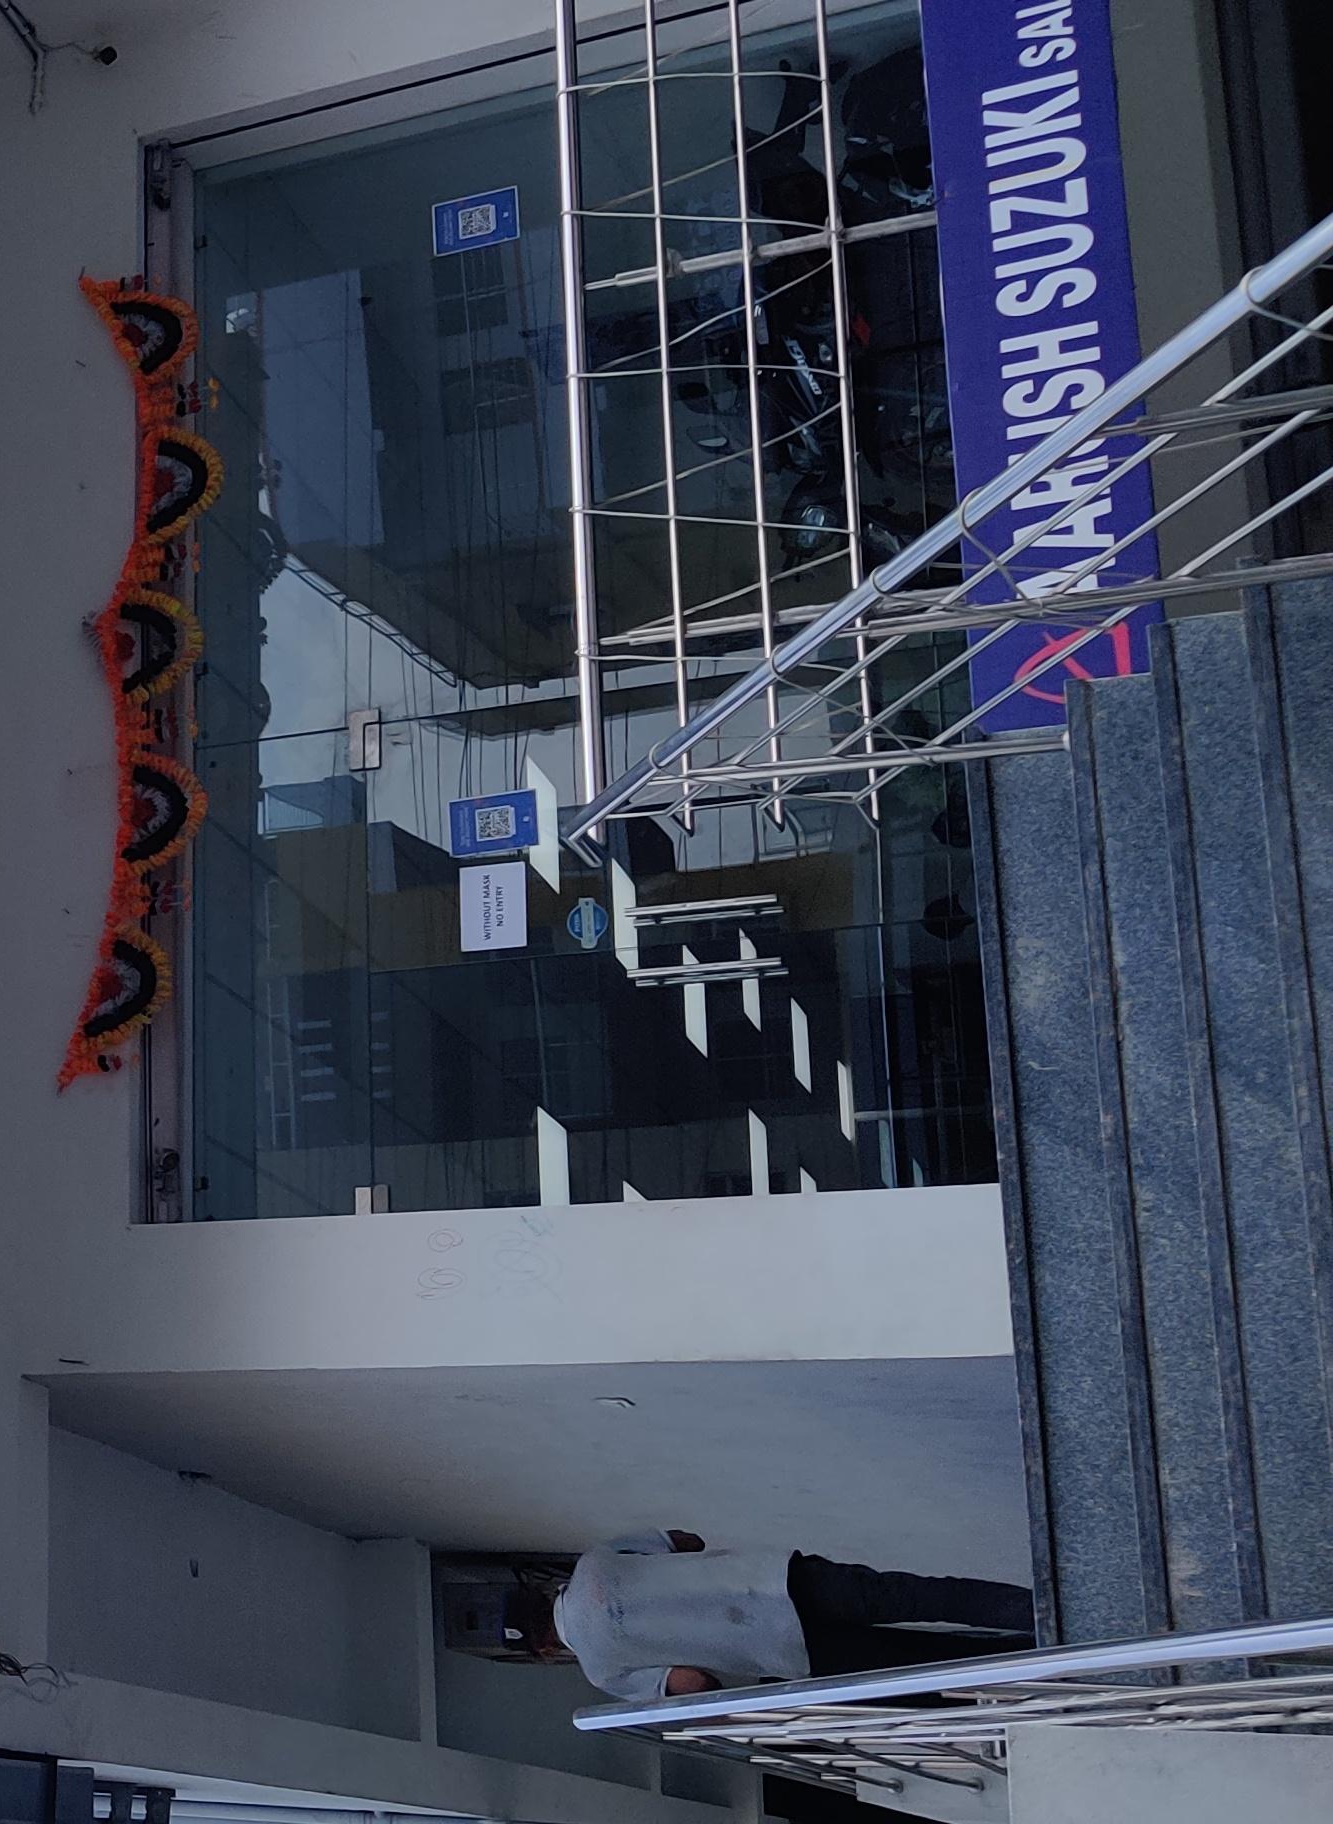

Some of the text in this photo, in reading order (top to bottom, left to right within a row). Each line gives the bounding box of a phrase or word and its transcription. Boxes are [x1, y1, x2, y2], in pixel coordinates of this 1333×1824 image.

[981, 70, 1098, 317] SUZUKI
[482, 874, 493, 941] WITHOUT MASK
[495, 886, 505, 927] NO ENTRY
